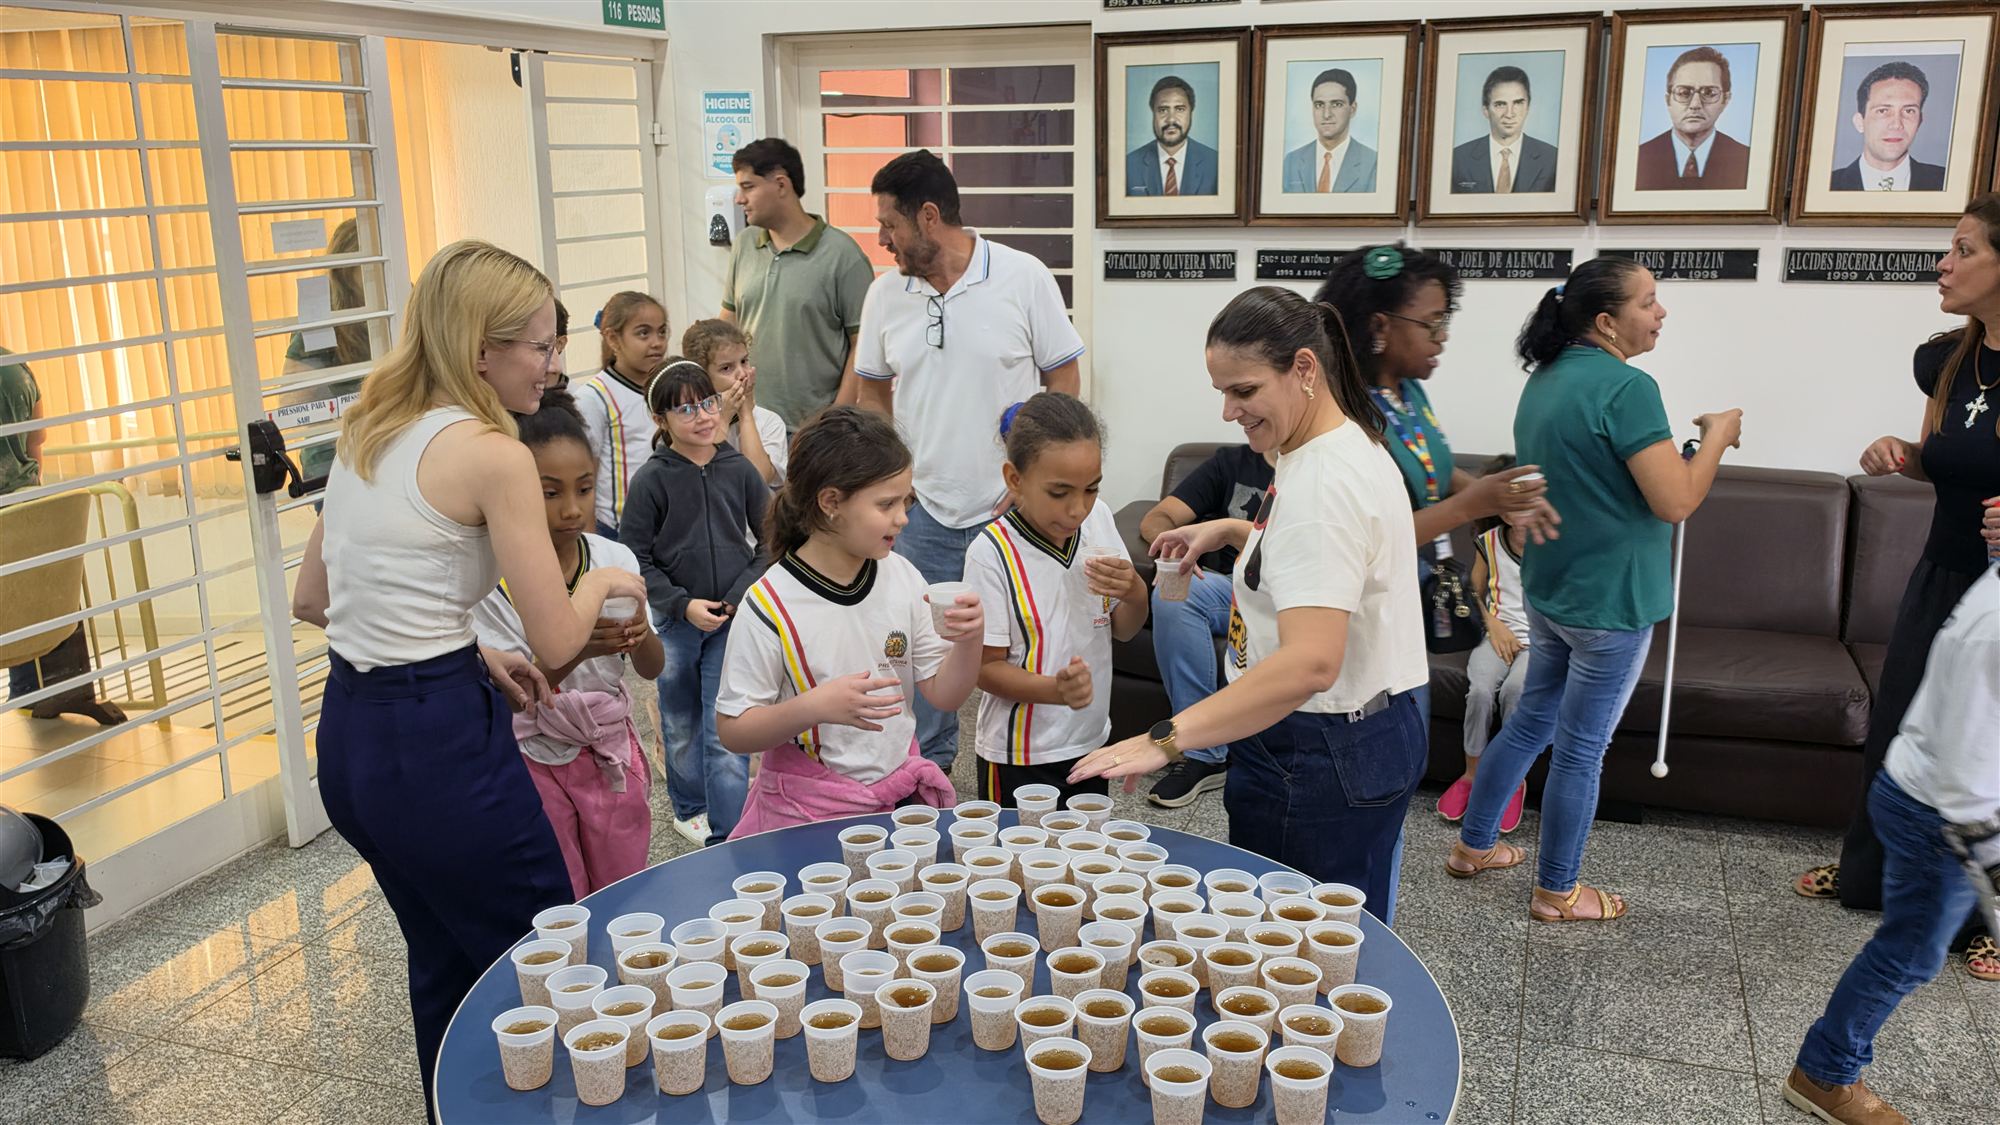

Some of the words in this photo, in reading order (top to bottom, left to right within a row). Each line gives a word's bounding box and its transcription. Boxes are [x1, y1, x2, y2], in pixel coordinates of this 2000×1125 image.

[608, 1, 622, 20] 116
[627, 4, 661, 24] PESSOAS
[705, 98, 750, 110] HIGIENE
[1150, 254, 1161, 270] DE
[1162, 254, 1206, 270] OLIVEIRA
[1209, 254, 1233, 270] NETO
[1280, 255, 1298, 264] LUIZ
[1459, 251, 1485, 268] JOEL
[1488, 251, 1502, 268] DE
[1505, 251, 1555, 269] ALENCAR
[1671, 251, 1725, 269] FEREZIN
[1789, 252, 1834, 270] ALCIDES
[1835, 252, 1884, 271] BECERRA
[1886, 253, 1936, 271] CANHADA
[1136, 270, 1157, 278] 1991
[1179, 270, 1204, 278] 1992
[1491, 270, 1499, 278] A
[1507, 269, 1534, 278] 1996
[1689, 270, 1718, 279] 1998
[1827, 271, 1858, 280] 1999
[1866, 272, 1875, 280] A
[1883, 271, 1917, 280] 2000
[277, 404, 310, 417] PRESSIONE
[310, 401, 327, 411] PARA
